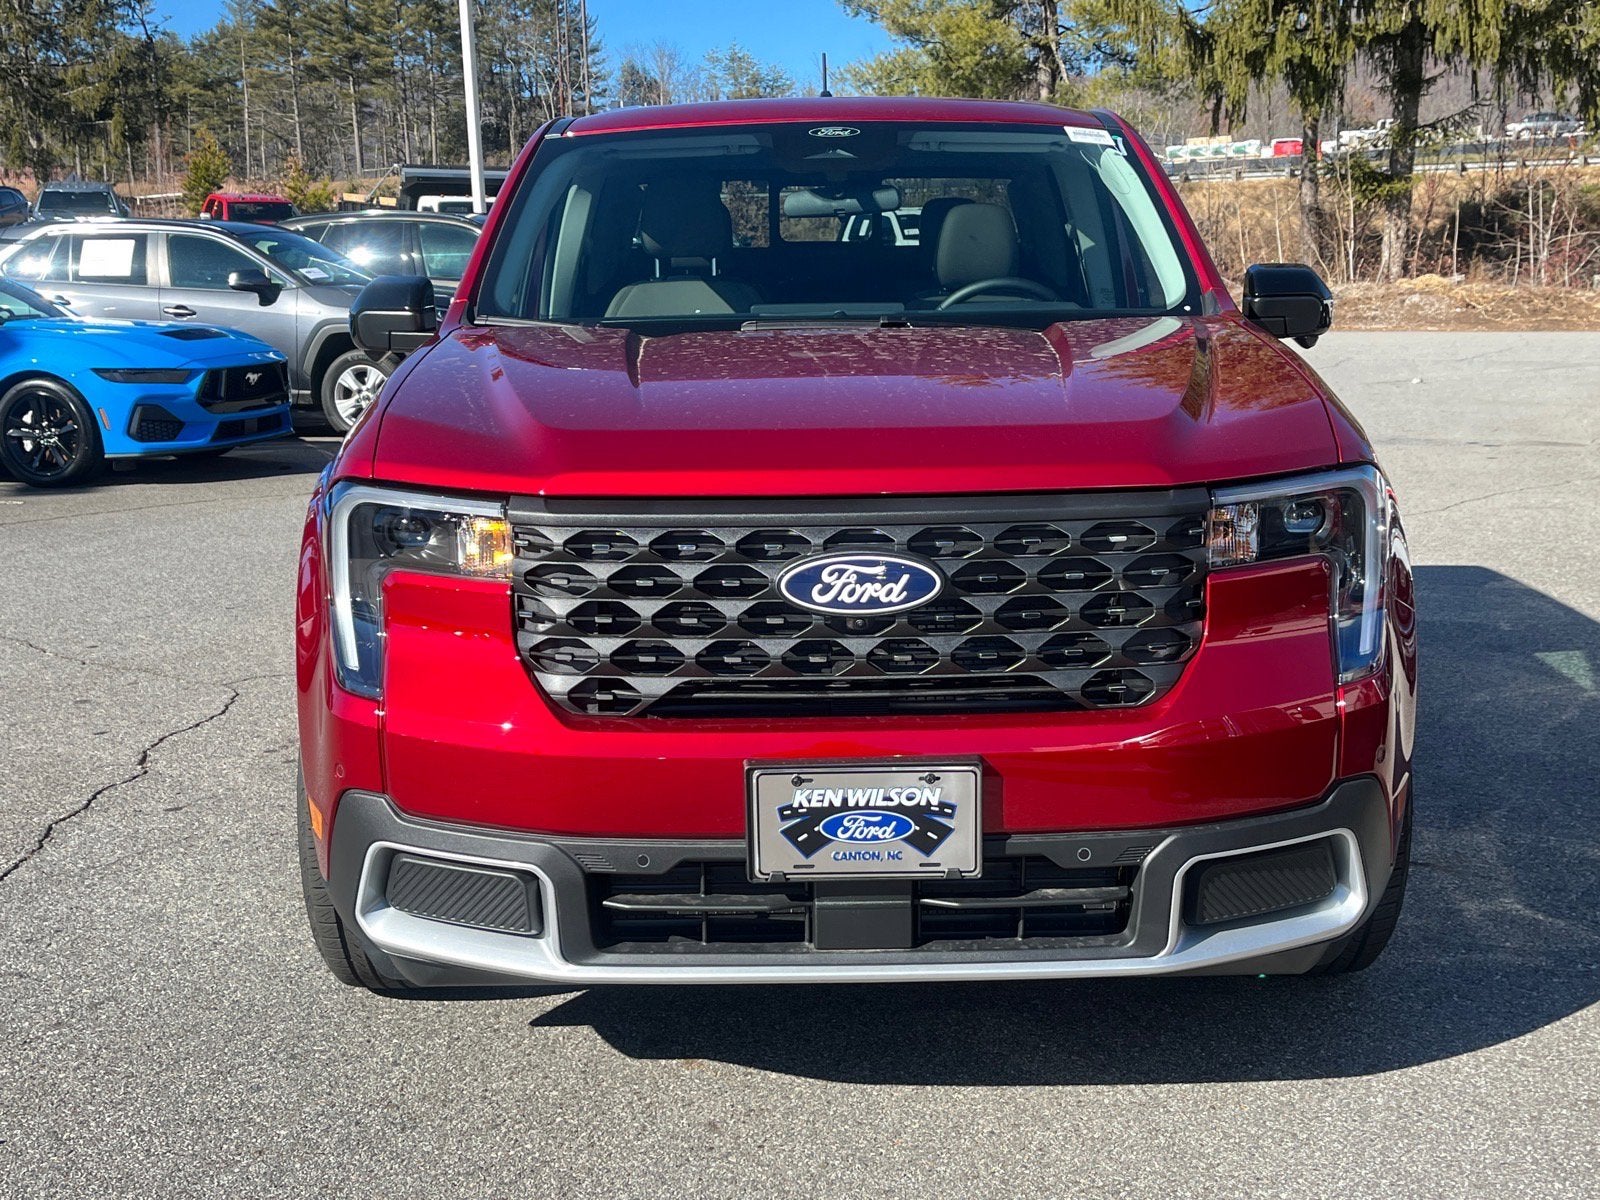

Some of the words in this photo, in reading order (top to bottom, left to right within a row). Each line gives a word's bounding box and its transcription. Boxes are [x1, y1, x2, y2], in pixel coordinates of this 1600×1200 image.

[817, 127, 851, 136] Ford
[811, 563, 910, 604] Ford
[792, 787, 843, 808] KEN
[846, 786, 942, 807] WILSON
[836, 814, 898, 840] Ford
[832, 851, 884, 862] CANTON,
[886, 851, 903, 861] NC
